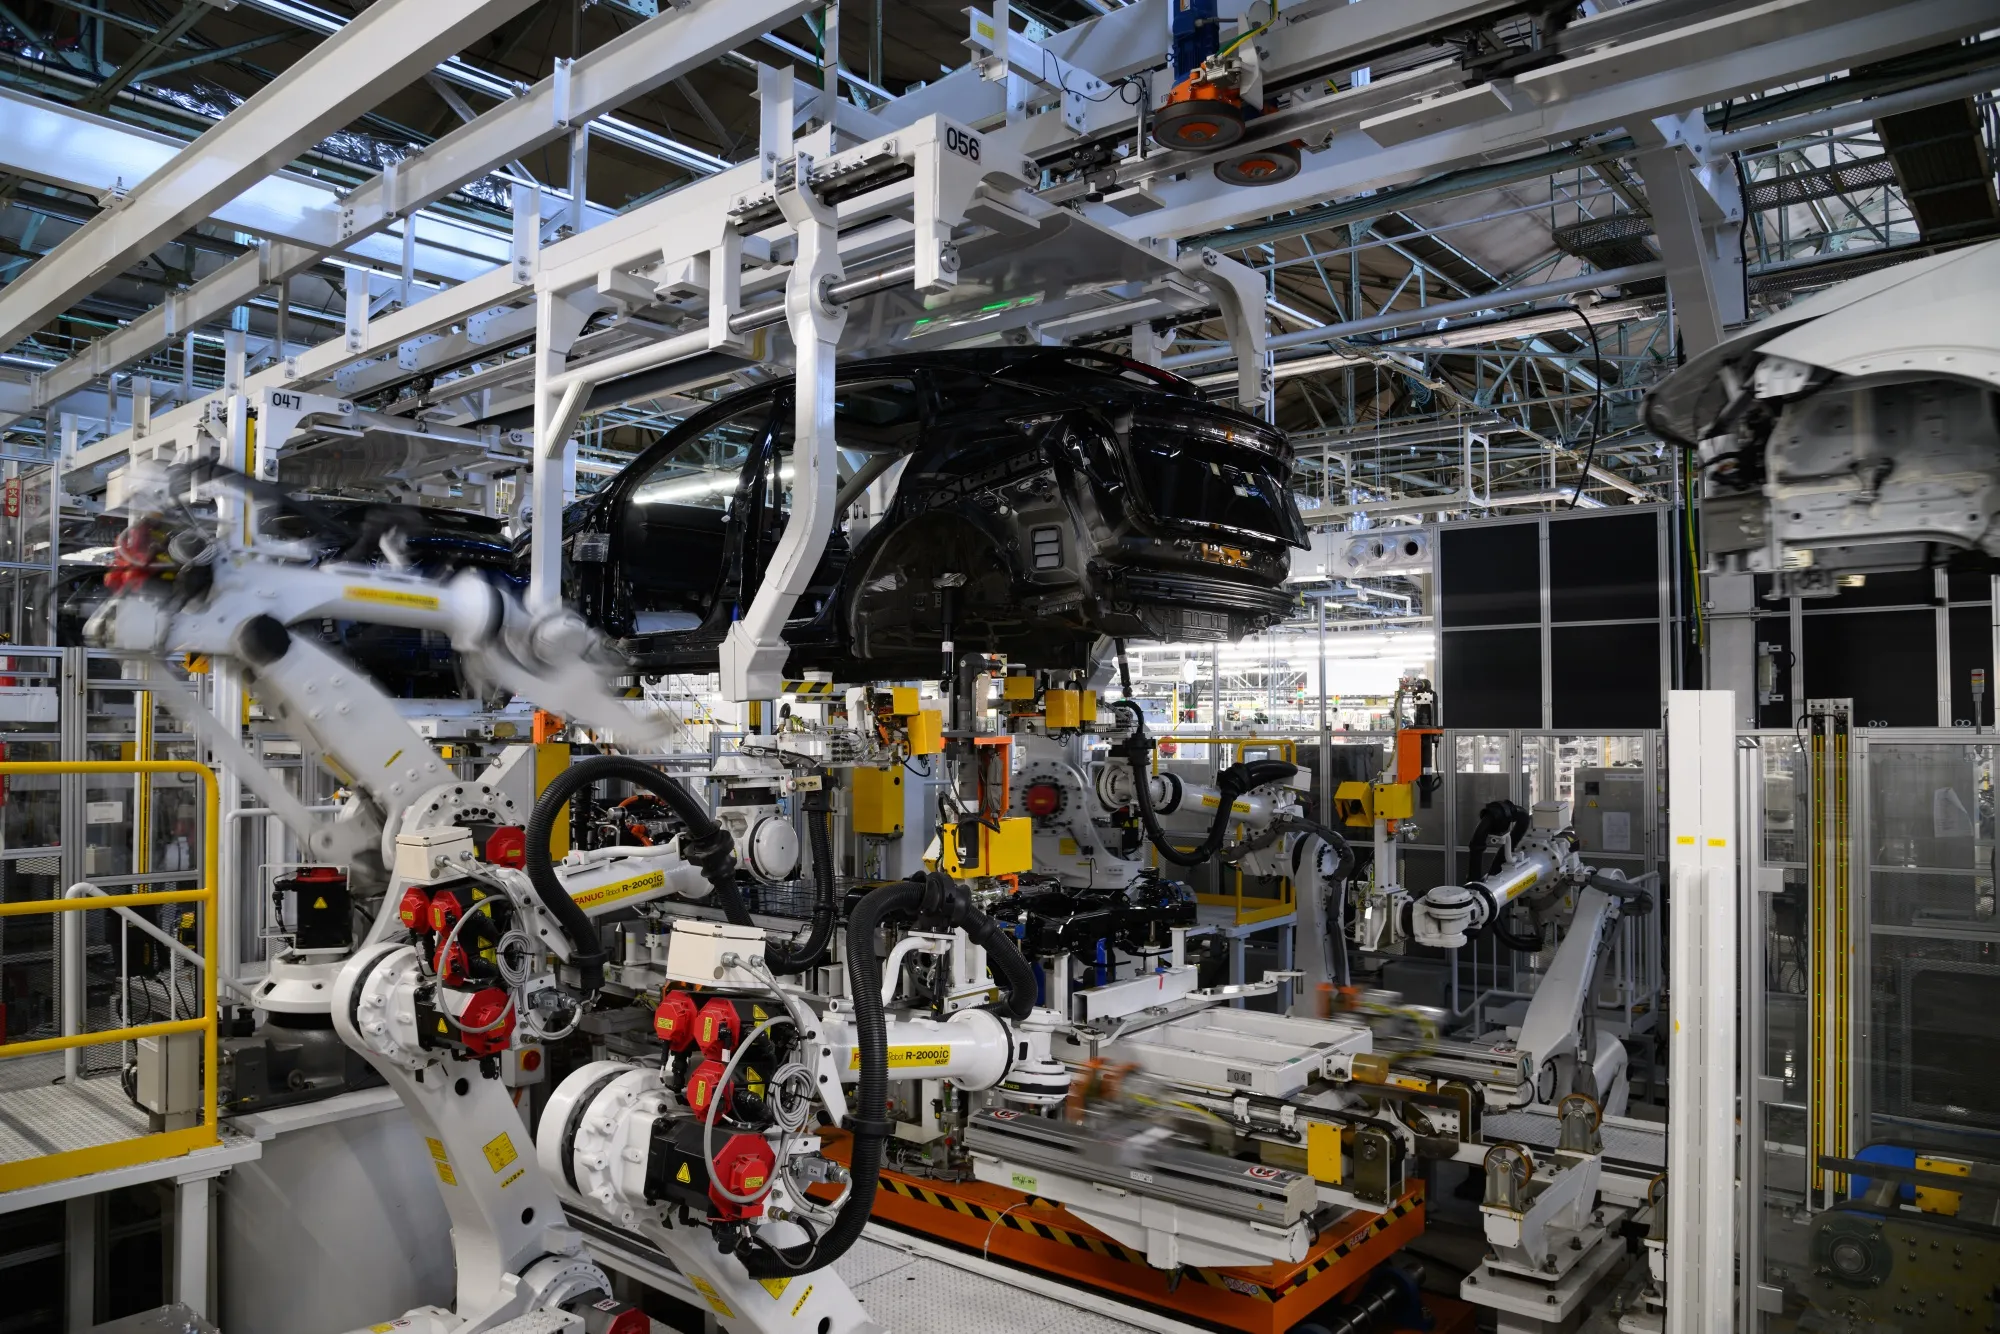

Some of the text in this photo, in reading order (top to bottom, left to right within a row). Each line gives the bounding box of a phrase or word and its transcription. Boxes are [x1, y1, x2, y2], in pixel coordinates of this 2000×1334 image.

[947, 127, 979, 161] 056
[272, 392, 300, 410] 047
[8, 480, 18, 505] 消火器
[573, 873, 663, 905] FANUC Robot R-2000iC
[888, 1046, 949, 1061] Robot R-2000iC
[1233, 1071, 1246, 1082] 04
